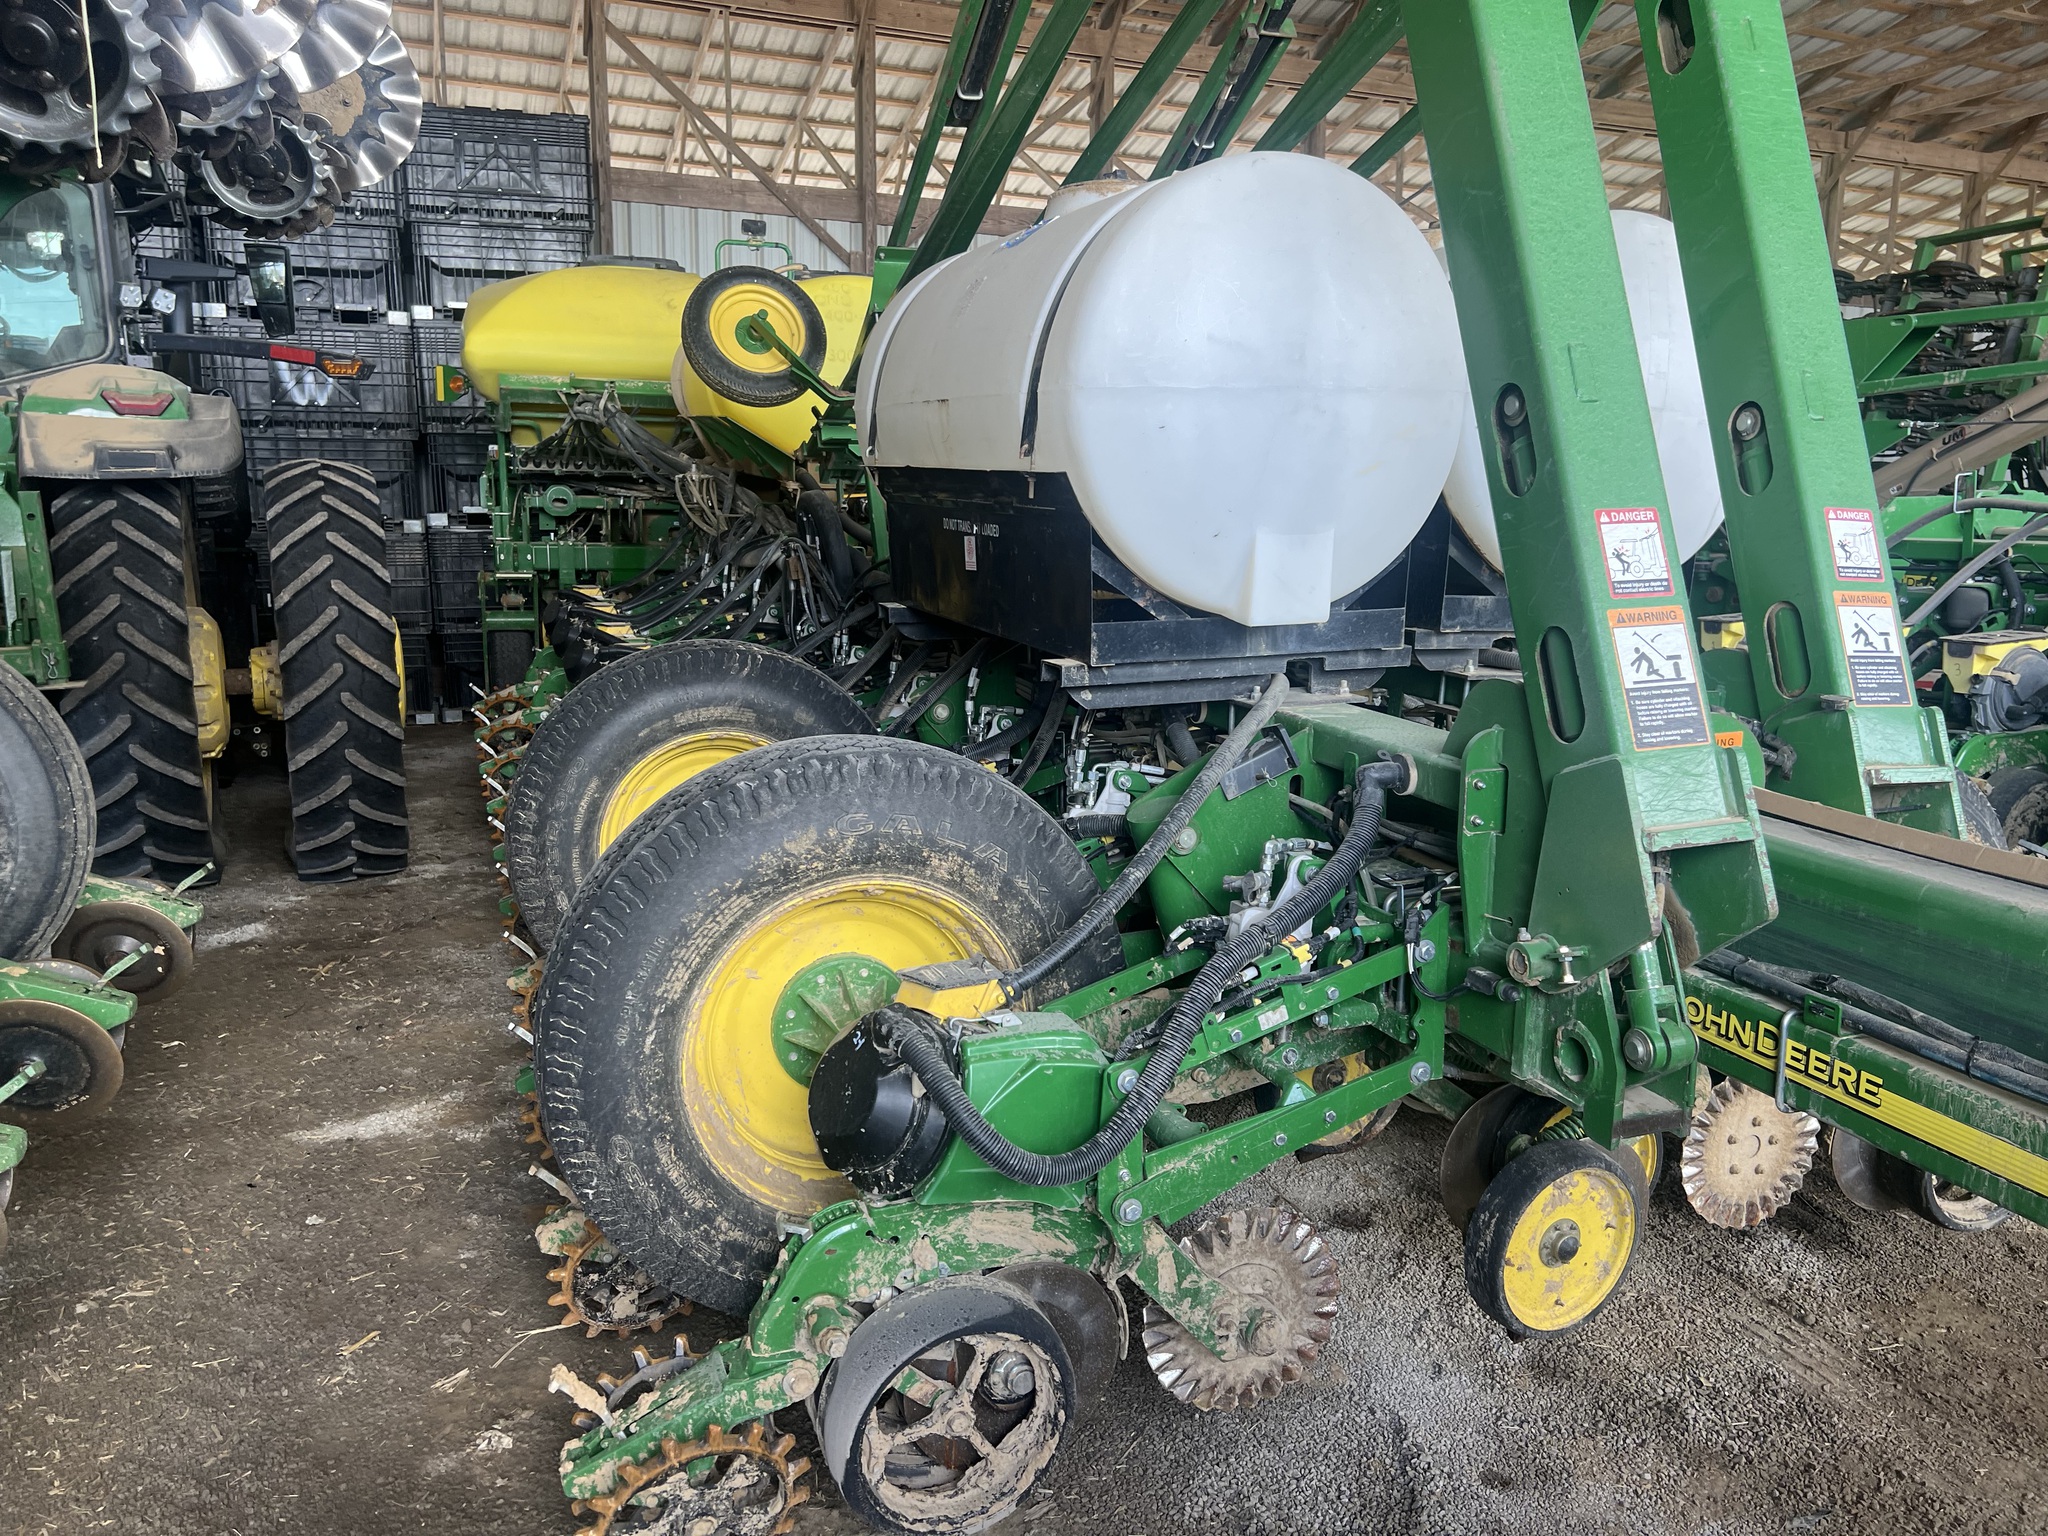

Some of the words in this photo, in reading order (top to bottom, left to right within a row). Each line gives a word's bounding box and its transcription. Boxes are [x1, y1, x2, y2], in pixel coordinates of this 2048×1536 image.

[1611, 511, 1655, 521] DANGER
[1836, 510, 1870, 520] DANGER
[982, 523, 1000, 537] LOADED
[1848, 595, 1887, 604] WARNING
[1626, 610, 1678, 622] WARNING
[1716, 738, 1734, 746] ING
[1685, 996, 1752, 1049] OHN
[1755, 1020, 1884, 1108] DEERE
